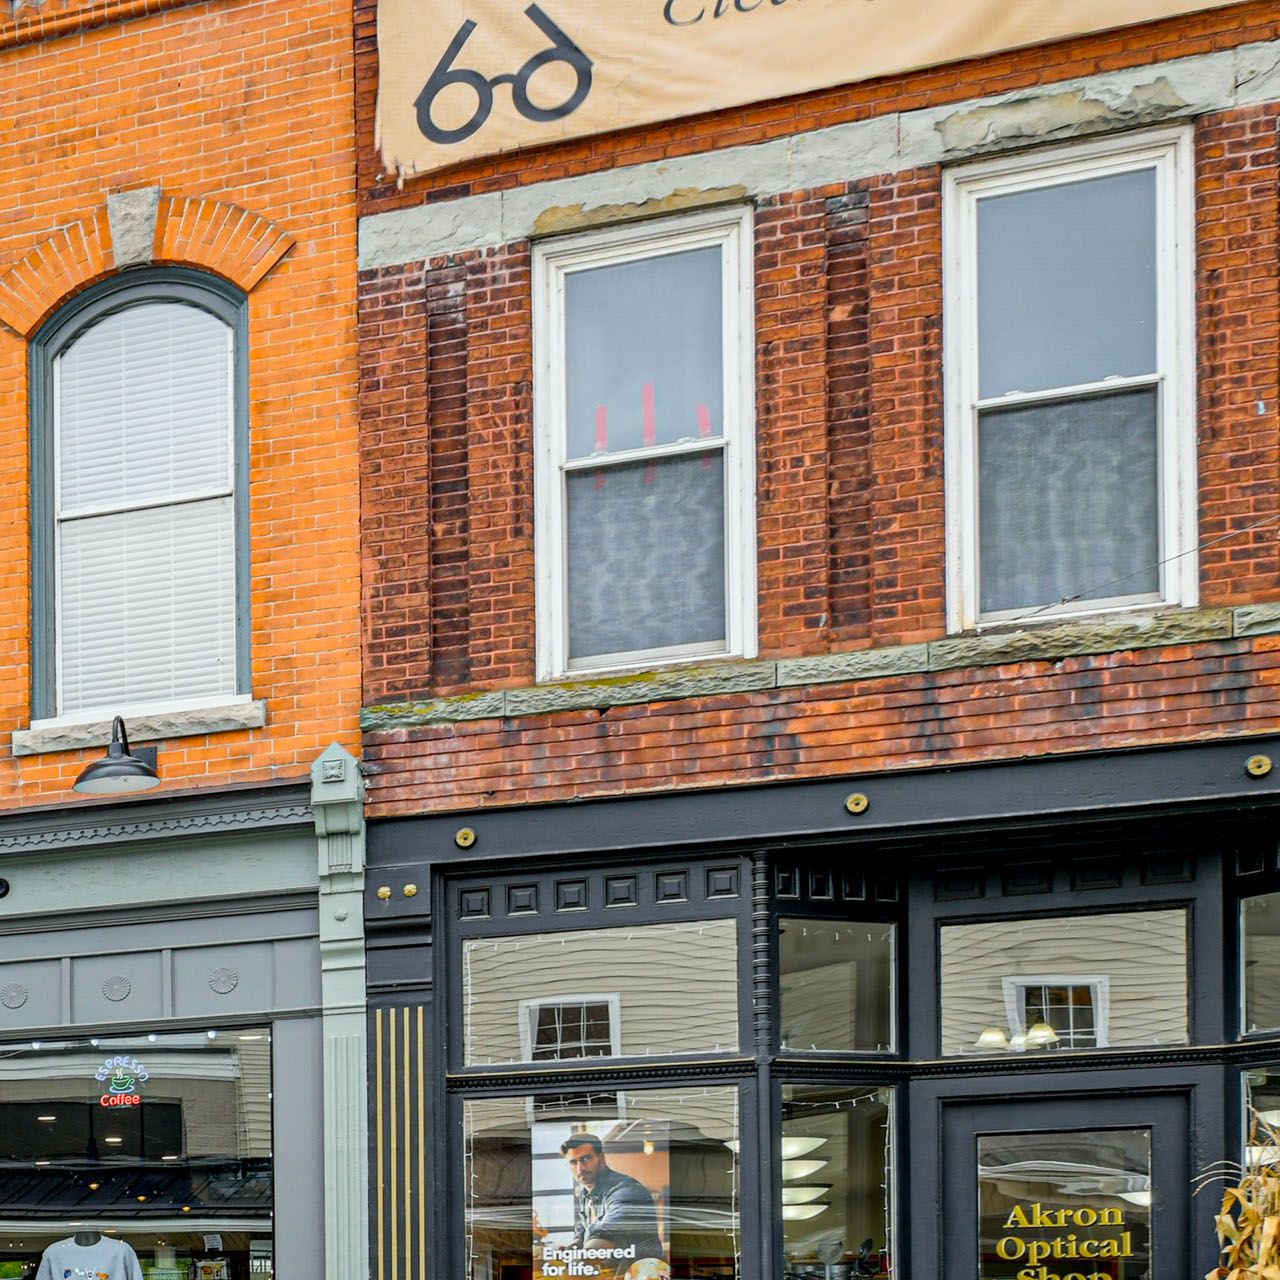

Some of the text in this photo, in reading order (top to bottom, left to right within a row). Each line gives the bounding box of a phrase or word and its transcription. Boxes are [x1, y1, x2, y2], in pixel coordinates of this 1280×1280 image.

[95, 1056, 148, 1081] ESPRESSO
[100, 1094, 140, 1106] Coffee
[1003, 1203, 1125, 1228] Akron
[542, 1244, 635, 1263] Engineered
[996, 1231, 1134, 1266] Optical
[542, 1262, 600, 1276] for life.
